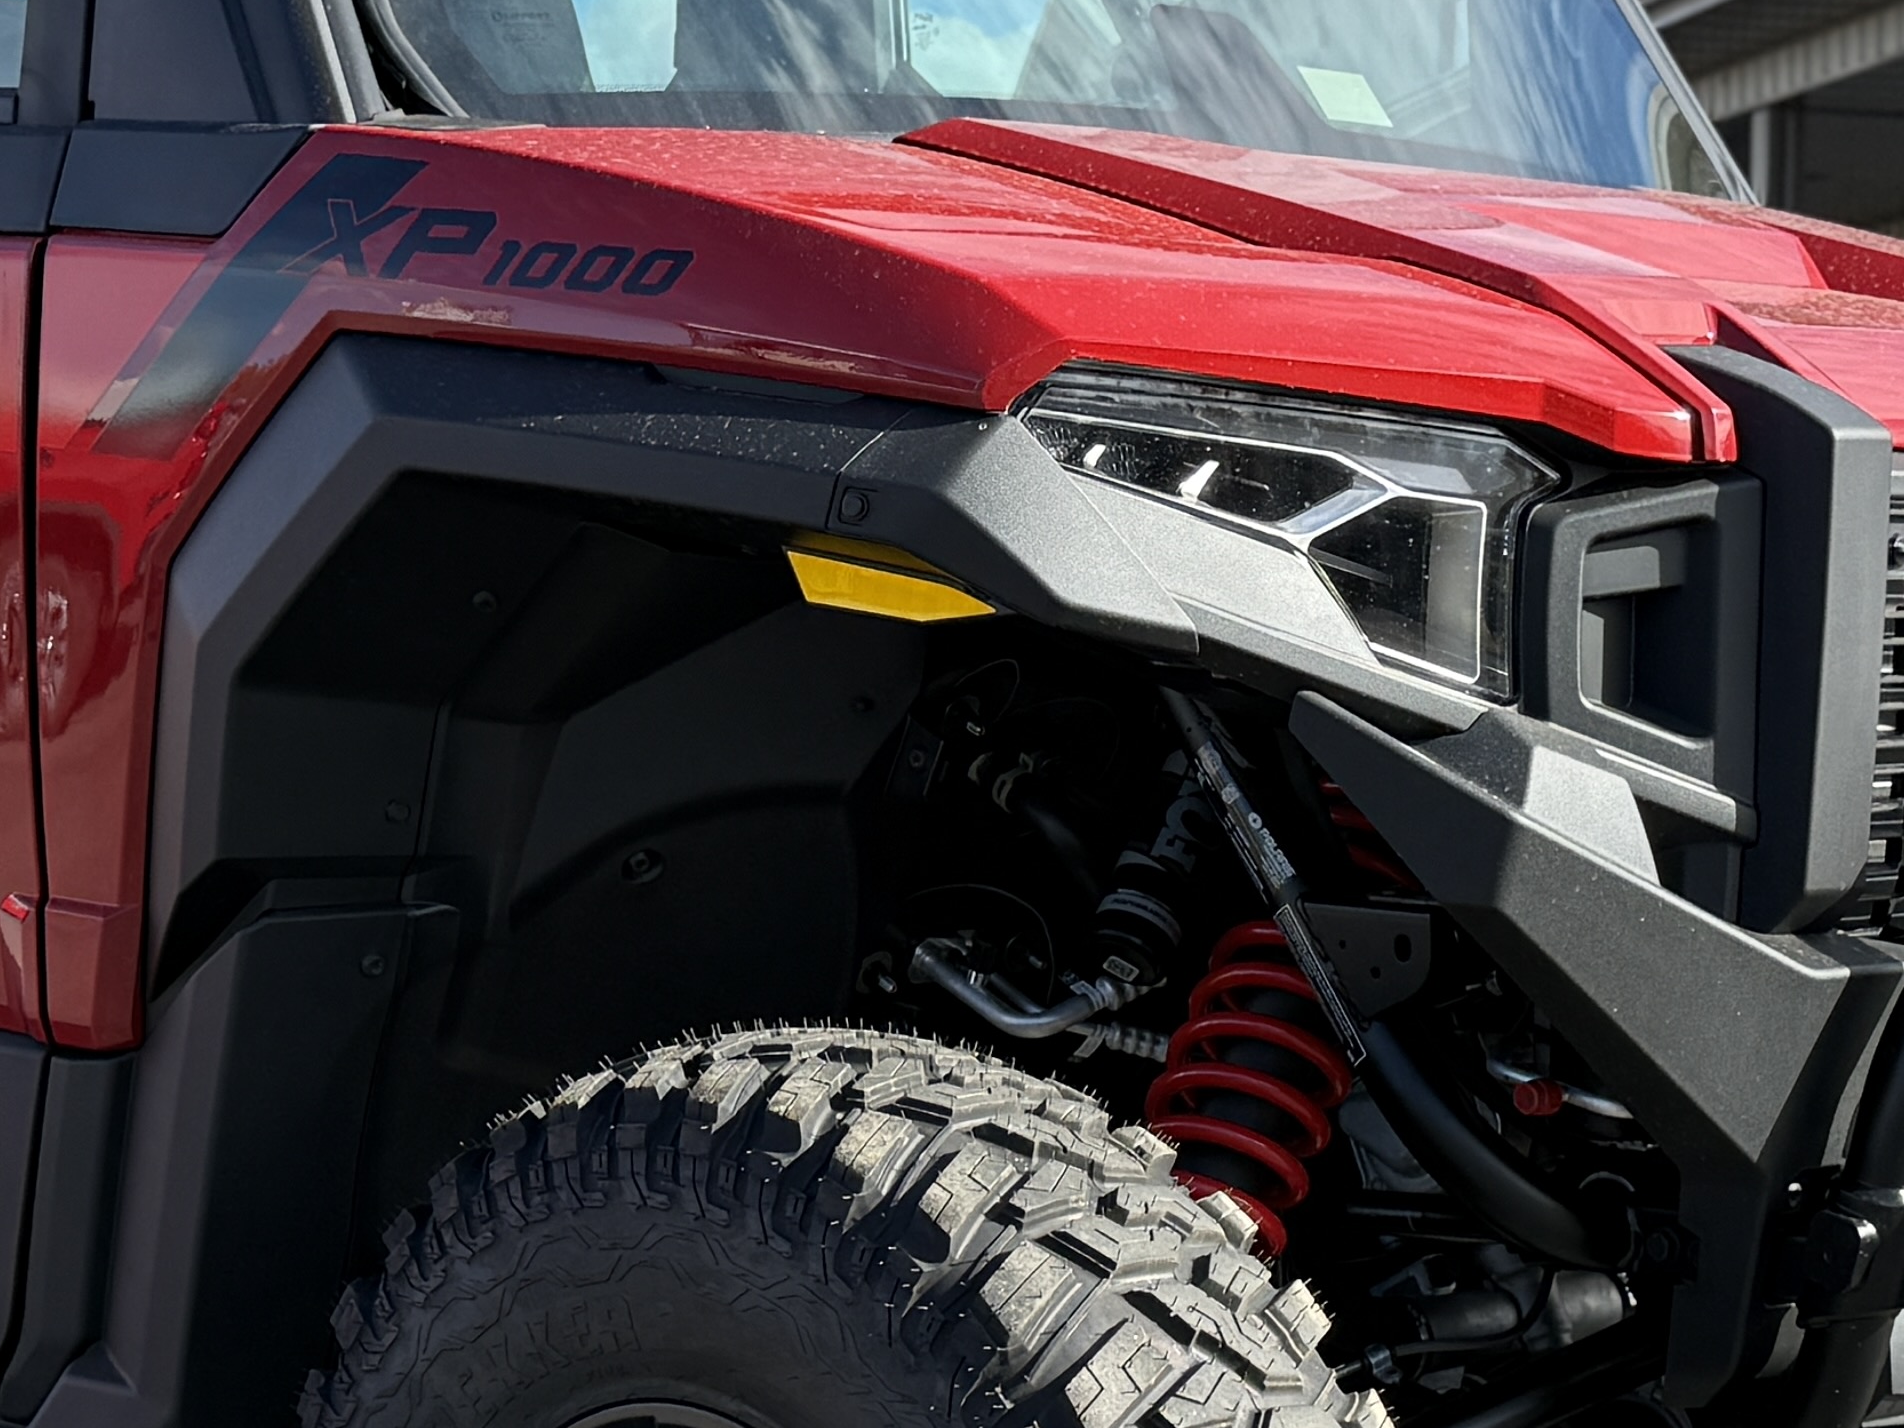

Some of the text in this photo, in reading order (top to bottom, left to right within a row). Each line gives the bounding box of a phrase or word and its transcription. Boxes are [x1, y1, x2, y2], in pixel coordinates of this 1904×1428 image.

[281, 198, 694, 297] XP 1000
[1151, 777, 1214, 874] FO
